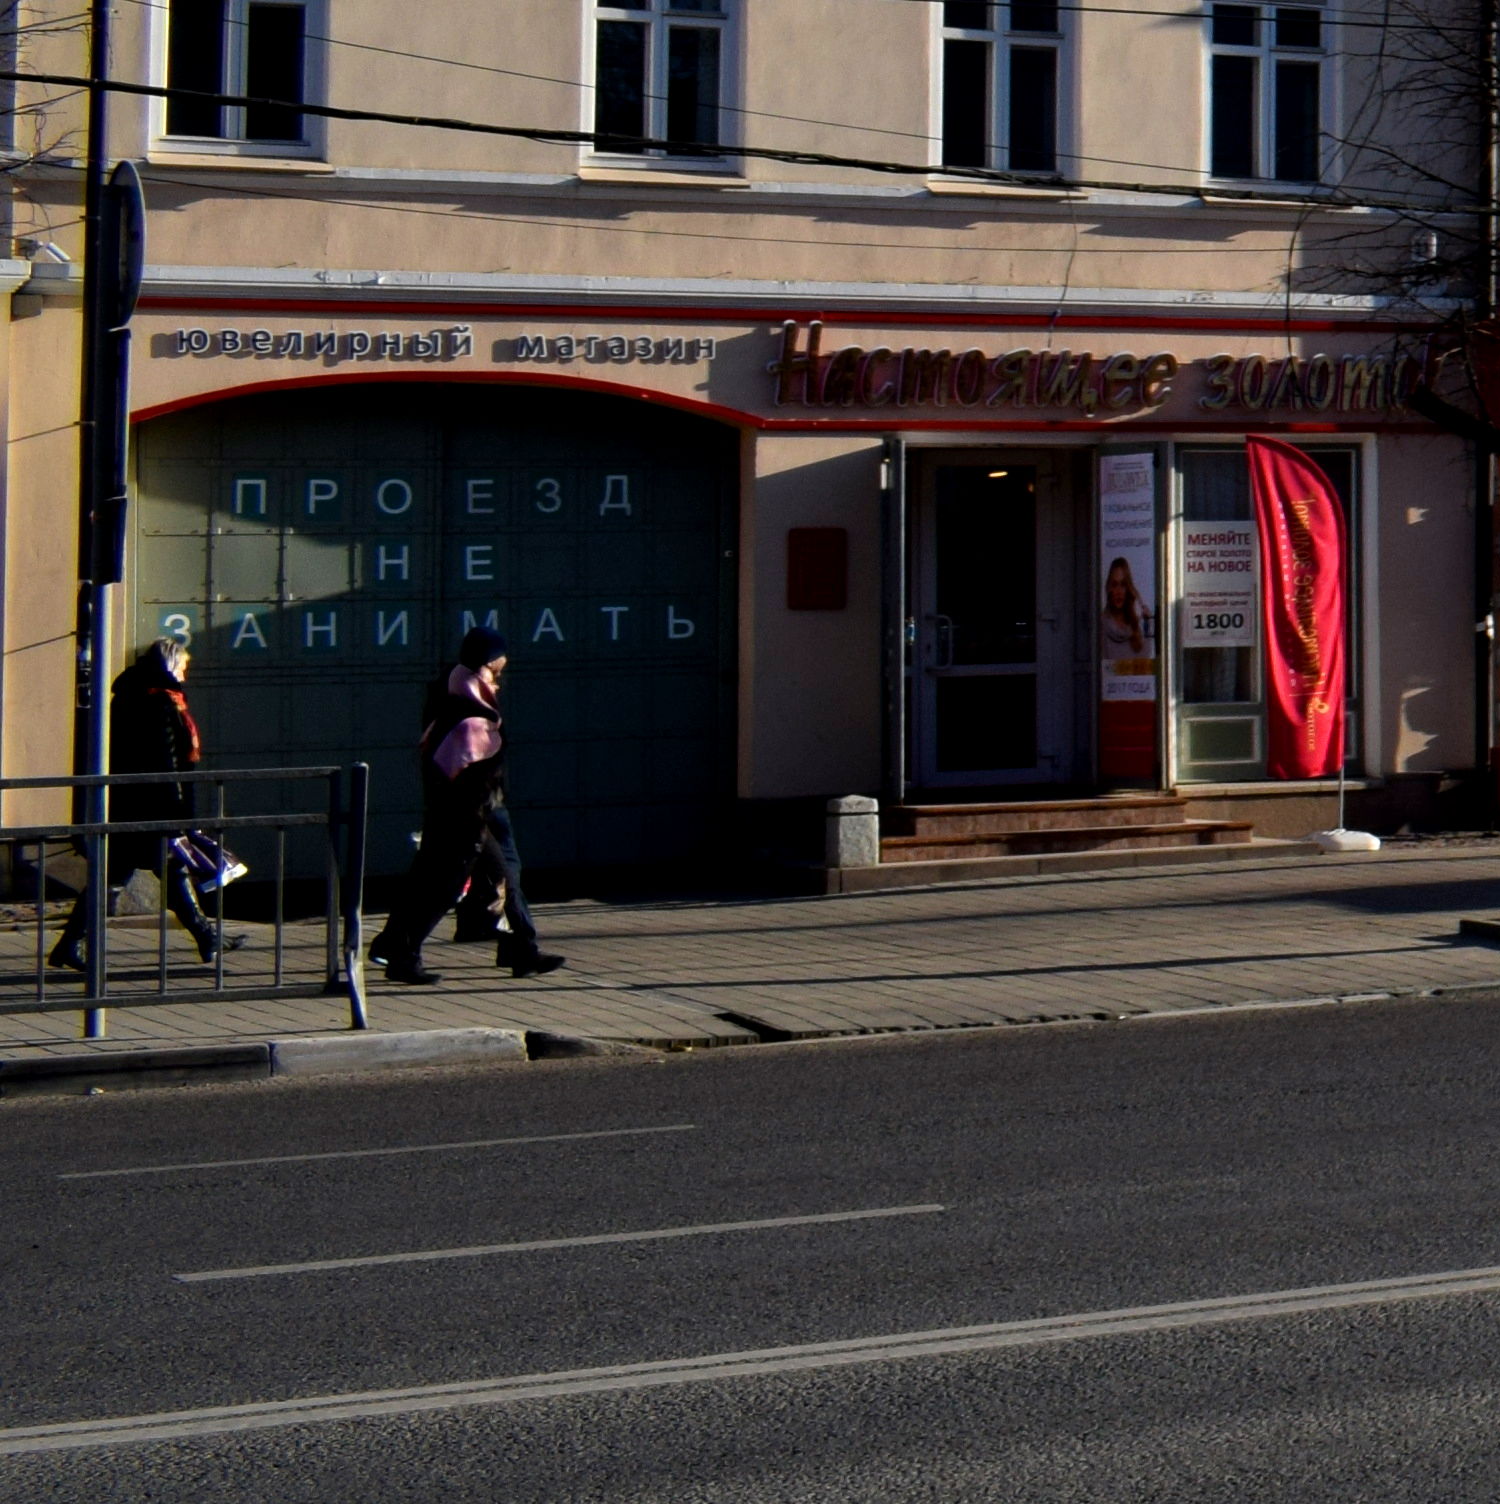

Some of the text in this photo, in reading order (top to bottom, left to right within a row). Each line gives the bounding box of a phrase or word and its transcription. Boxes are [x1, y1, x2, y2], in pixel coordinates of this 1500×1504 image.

[177, 324, 717, 362] ювелирный магазин
[766, 318, 1179, 418] Настоящее
[234, 474, 632, 517] ПРОЕЗД
[1187, 531, 1251, 545] МЕНЯЙТЕ
[378, 545, 494, 581] НЕ
[1187, 560, 1252, 573] НА НОВОЕ
[1193, 613, 1245, 630] 1800
